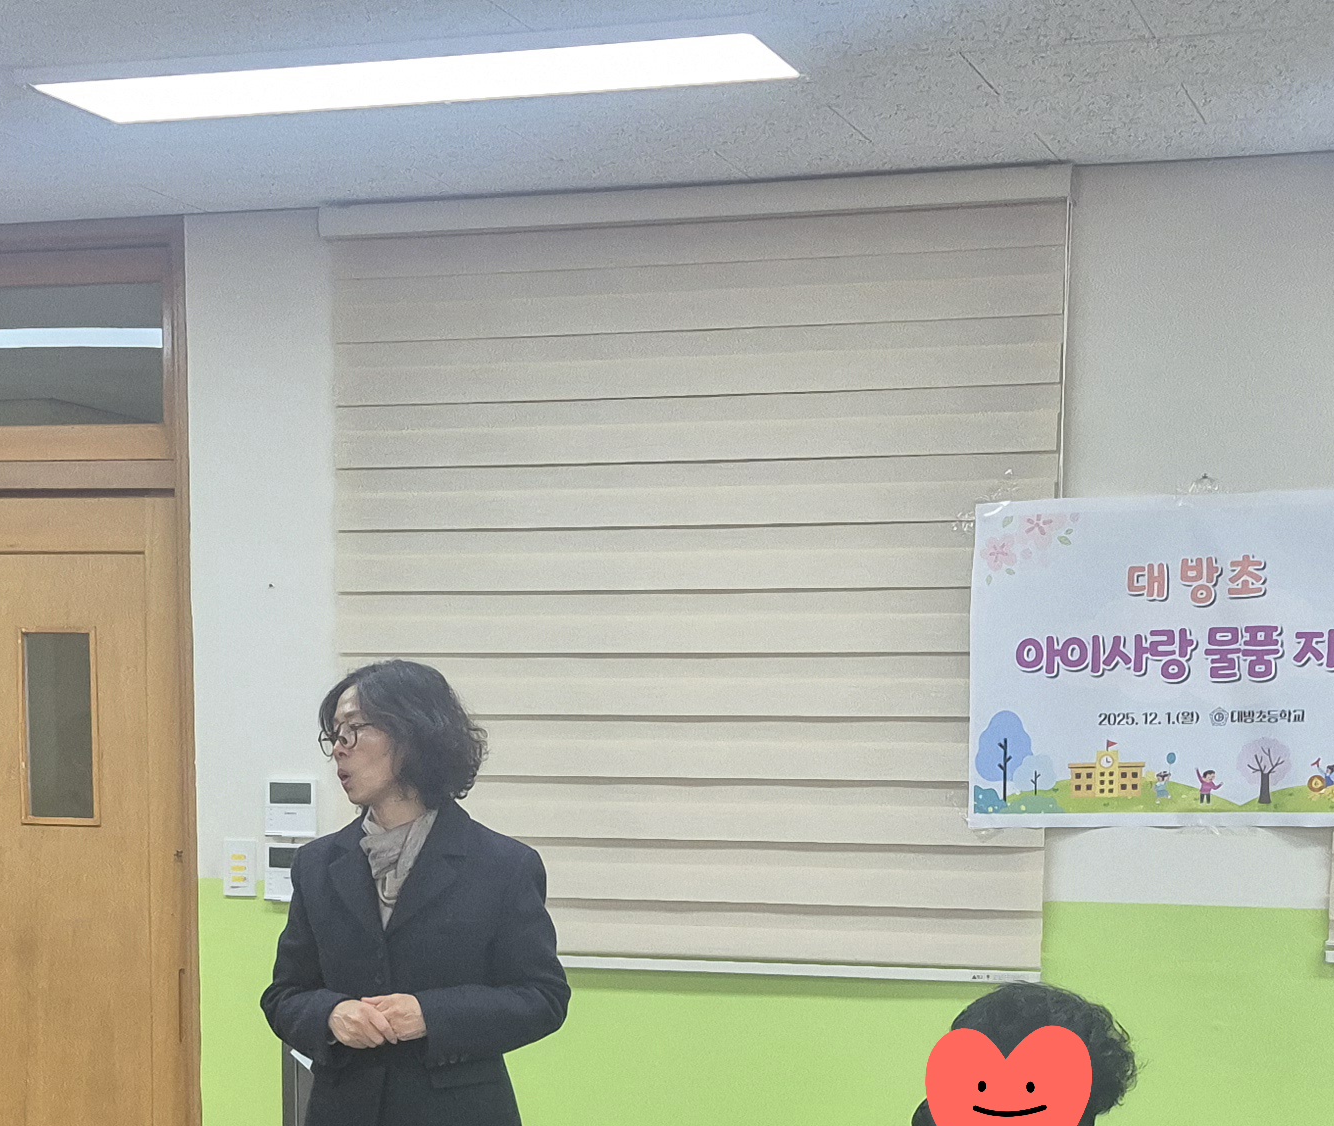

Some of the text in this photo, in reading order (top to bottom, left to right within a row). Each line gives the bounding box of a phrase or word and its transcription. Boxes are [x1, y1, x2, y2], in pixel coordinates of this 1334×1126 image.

[1014, 628, 1196, 681] 아이사랑
[1203, 625, 1285, 682] 물품
[1230, 709, 1305, 724] 대방초등학교
